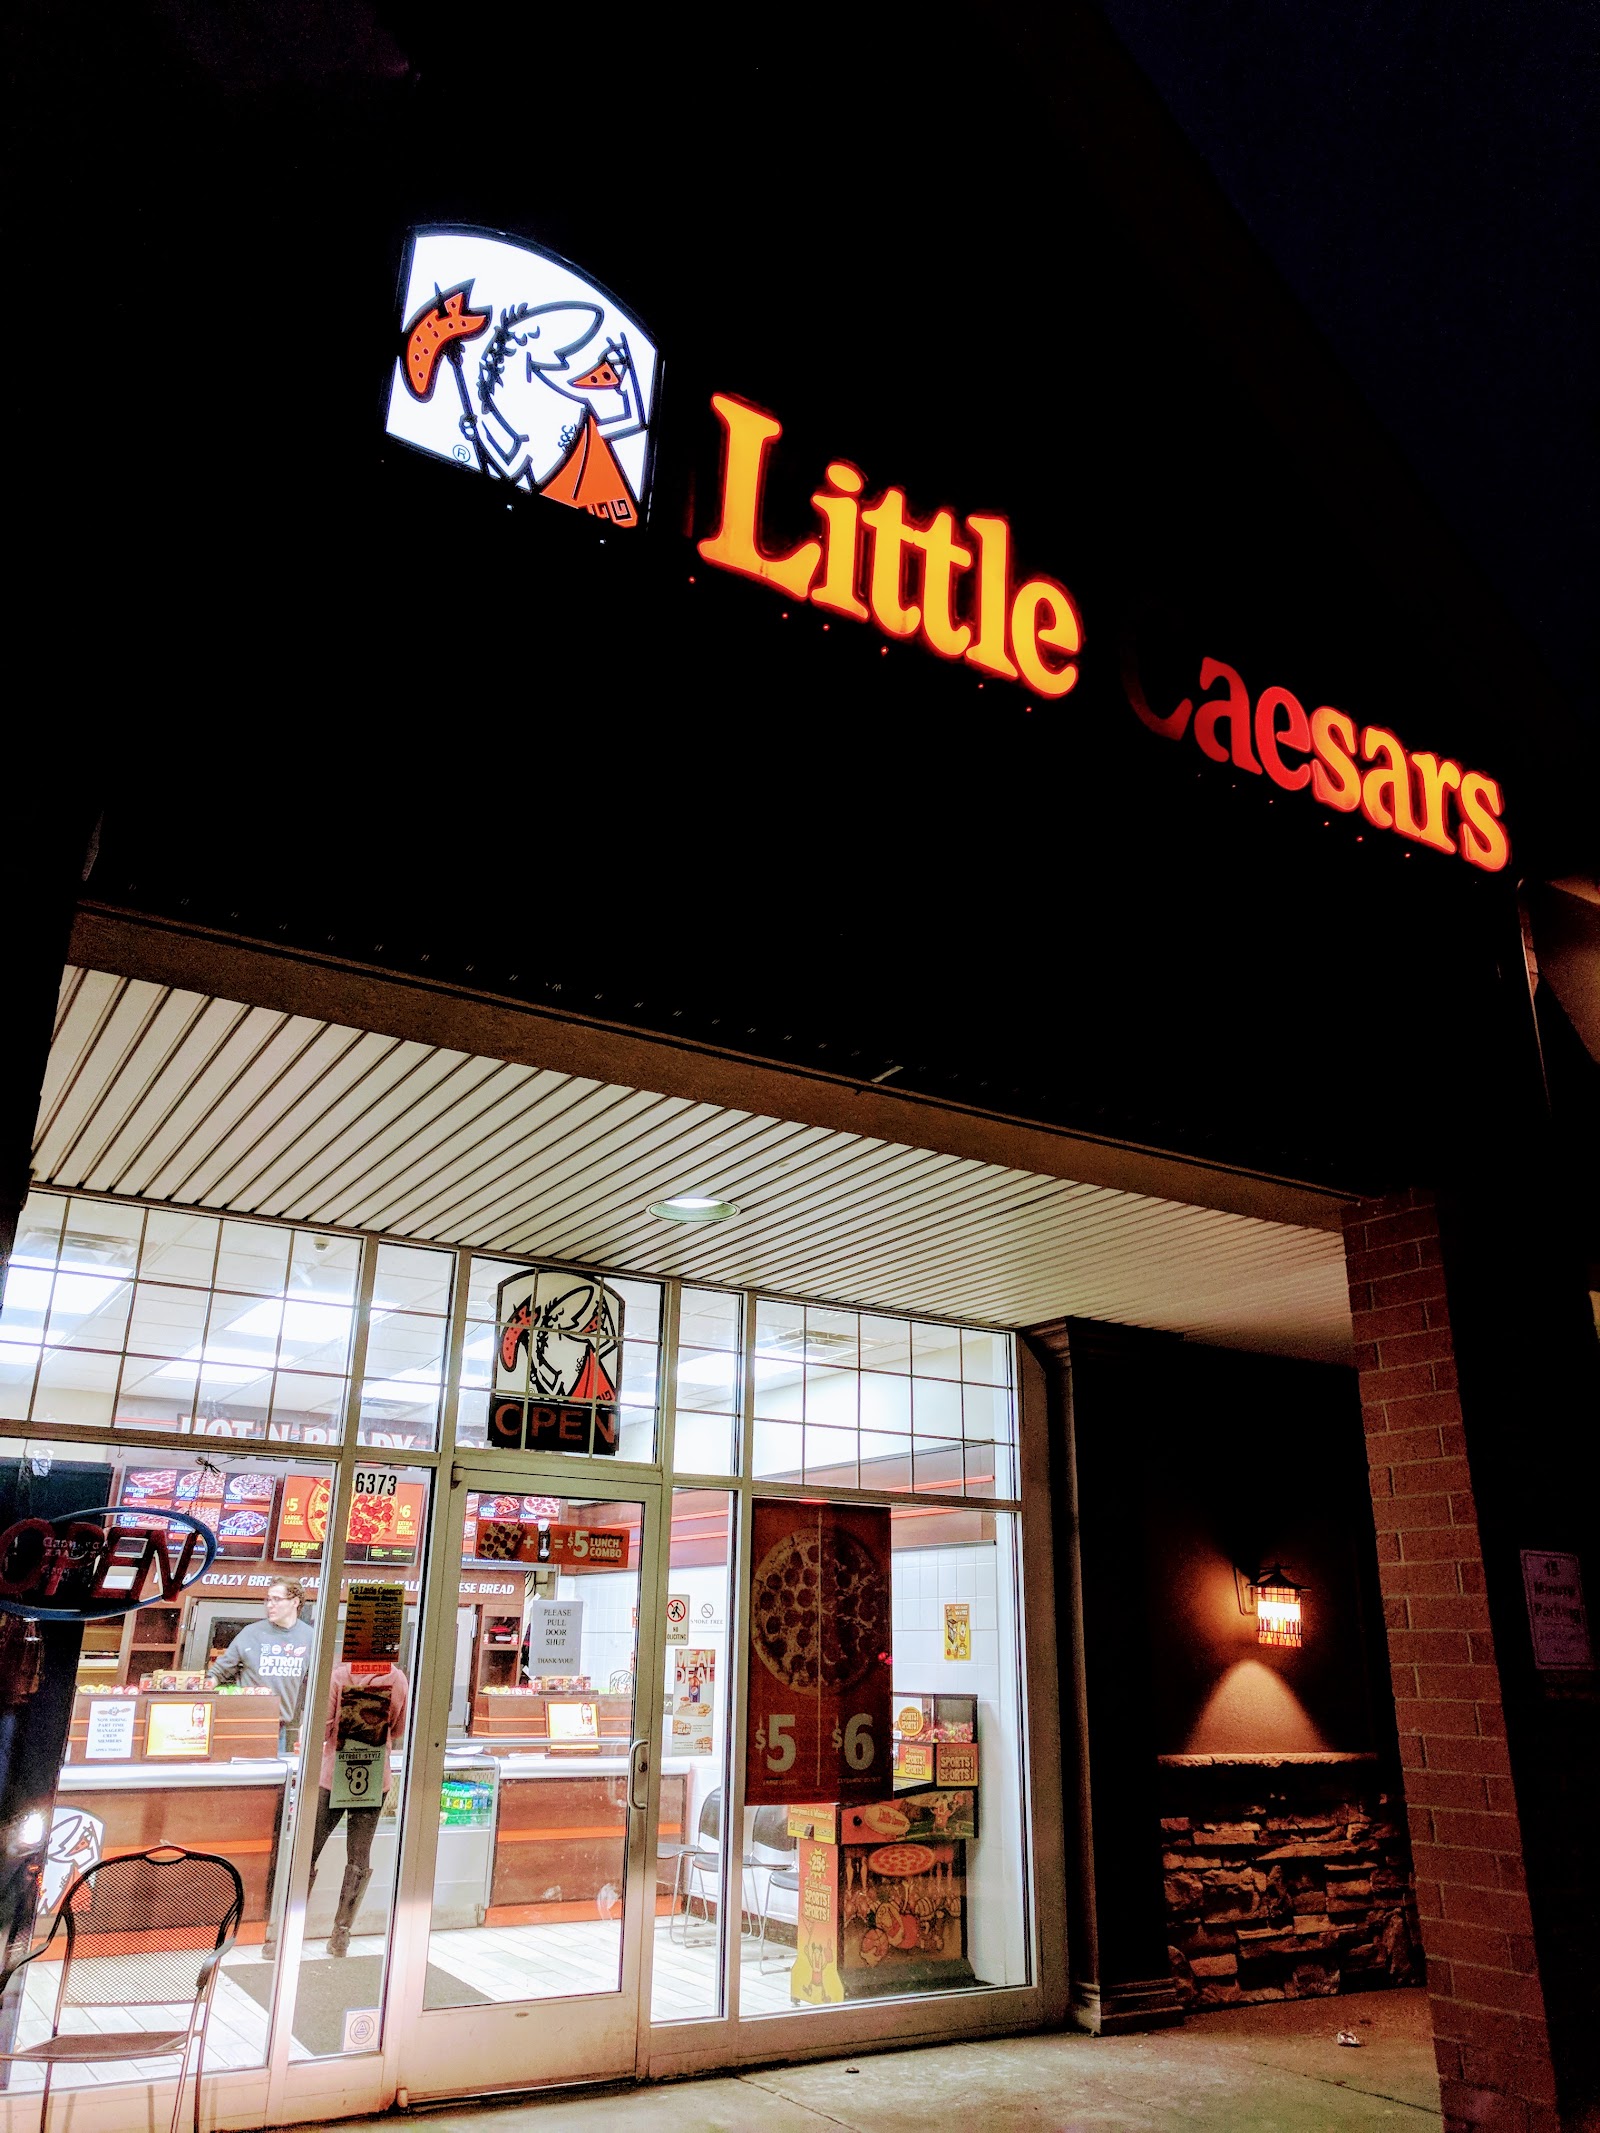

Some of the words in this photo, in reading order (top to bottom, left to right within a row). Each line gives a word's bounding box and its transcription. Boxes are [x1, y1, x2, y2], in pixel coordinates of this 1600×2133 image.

[697, 392, 1083, 698] Little
[495, 1403, 615, 1443] OPEN
[355, 1472, 397, 1496] 6373
[567, 1531, 589, 1558] $5
[590, 1538, 620, 1549] LUNCH
[590, 1547, 622, 1558] COMBO
[0, 1517, 201, 1602] OPEN
[202, 1573, 245, 1586] CRAZY
[247, 1575, 273, 1587] BRE
[478, 1583, 515, 1595] BREAD
[543, 1609, 572, 1617] PLEASE
[545, 1628, 567, 1636] DOOR
[667, 1633, 687, 1641] OLICITING
[546, 1638, 566, 1646] SHUT
[260, 1656, 303, 1668] DETROIT
[676, 1650, 715, 1668] MEAL
[258, 1666, 302, 1677] CLASSICS
[675, 1667, 715, 1685] DEAL
[754, 1714, 796, 1772] $5
[832, 1713, 875, 1770] $6
[940, 1756, 974, 1769] SPORTS!
[940, 1768, 974, 1781] SPORTS!
[804, 1888, 830, 1908] SPORTS!
[804, 1903, 830, 1922] SPORTS!
